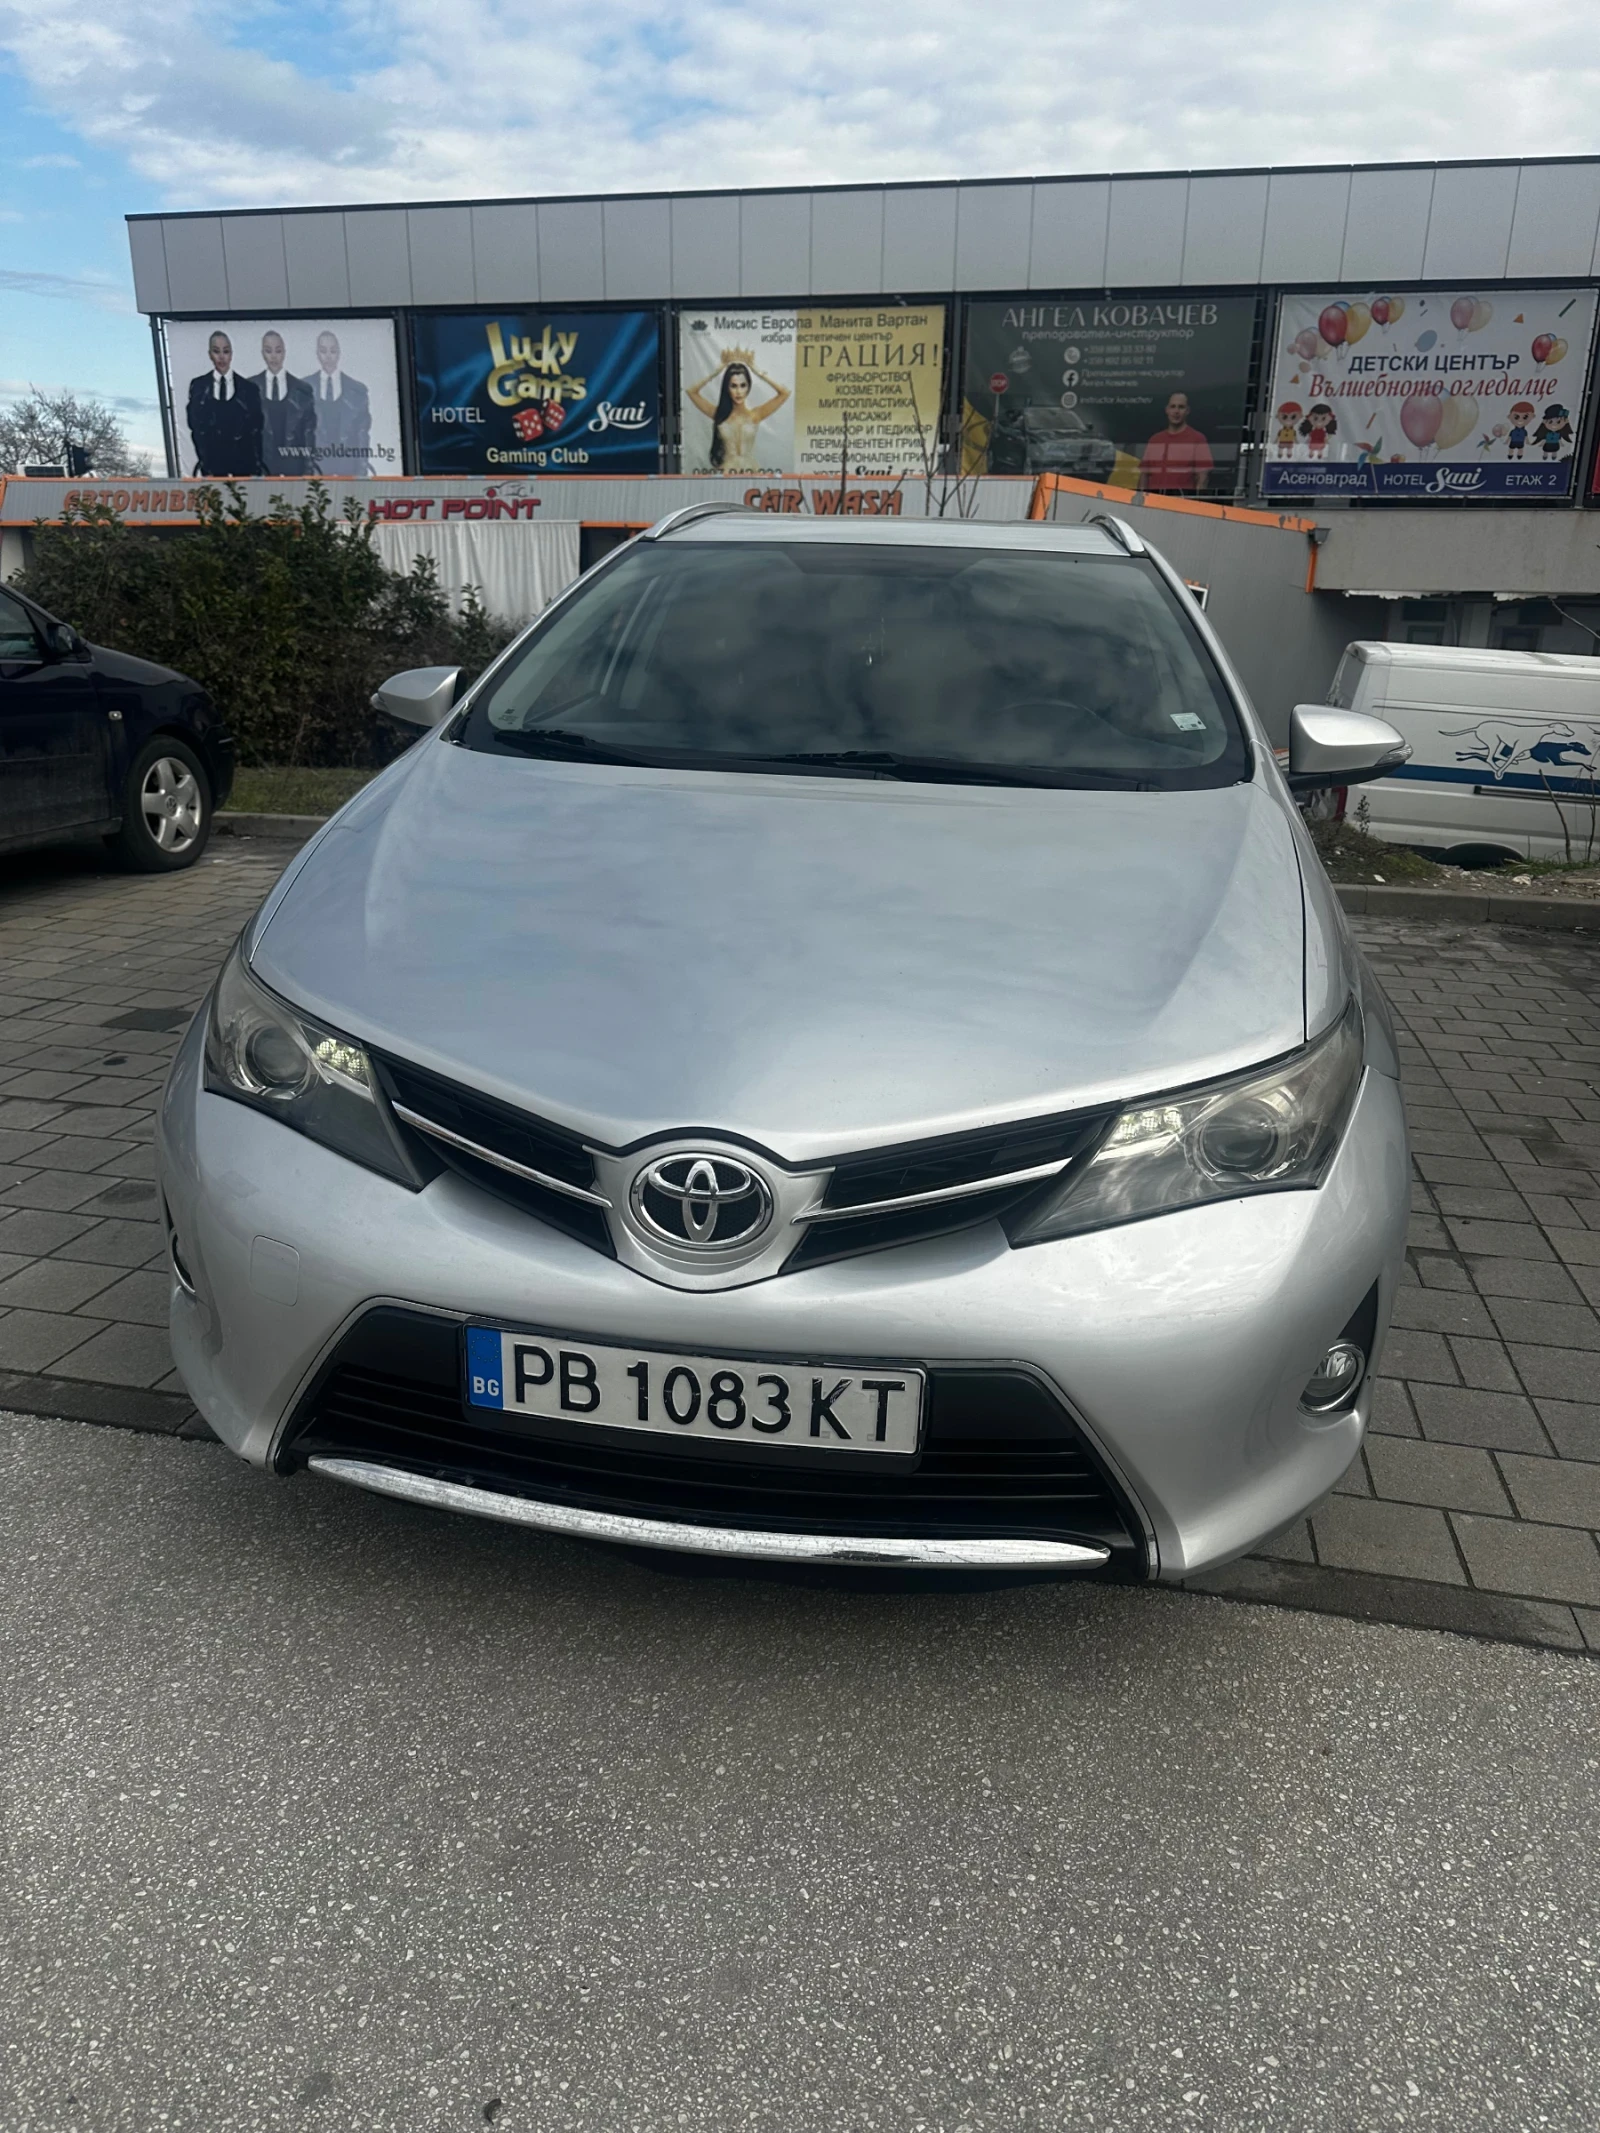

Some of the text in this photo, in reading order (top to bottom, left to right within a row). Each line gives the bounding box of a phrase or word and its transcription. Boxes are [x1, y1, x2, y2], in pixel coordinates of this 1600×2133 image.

[714, 312, 928, 332] Мисис Европа Манита Вартан
[1002, 304, 1218, 328] АНГЕЛ КОВАЧЕВ
[486, 322, 578, 375] Lucky
[803, 342, 938, 368] ГРАЦИЯ!
[1348, 354, 1520, 374] ДЕТСКИ ЦЕНТЪР
[487, 361, 587, 407] Games
[835, 384, 902, 396] КОЗМЕТИКА
[1309, 371, 1558, 401] Вълшебното огледалце
[432, 407, 485, 423] HOTEL
[588, 401, 653, 432] Sani
[278, 443, 396, 462] www.goldenm.bg
[487, 447, 589, 466] Gaming Club
[1278, 471, 1368, 487] Асеновград
[1383, 467, 1487, 493] HOTEL Sani
[1505, 474, 1557, 486] ЕТАЖ 2
[63, 489, 211, 513] АВТОМИВК
[369, 499, 435, 520] HOT
[744, 488, 904, 515] CAR WASH
[473, 1375, 500, 1397] BG
[514, 1342, 906, 1442] PB 1083 KT
